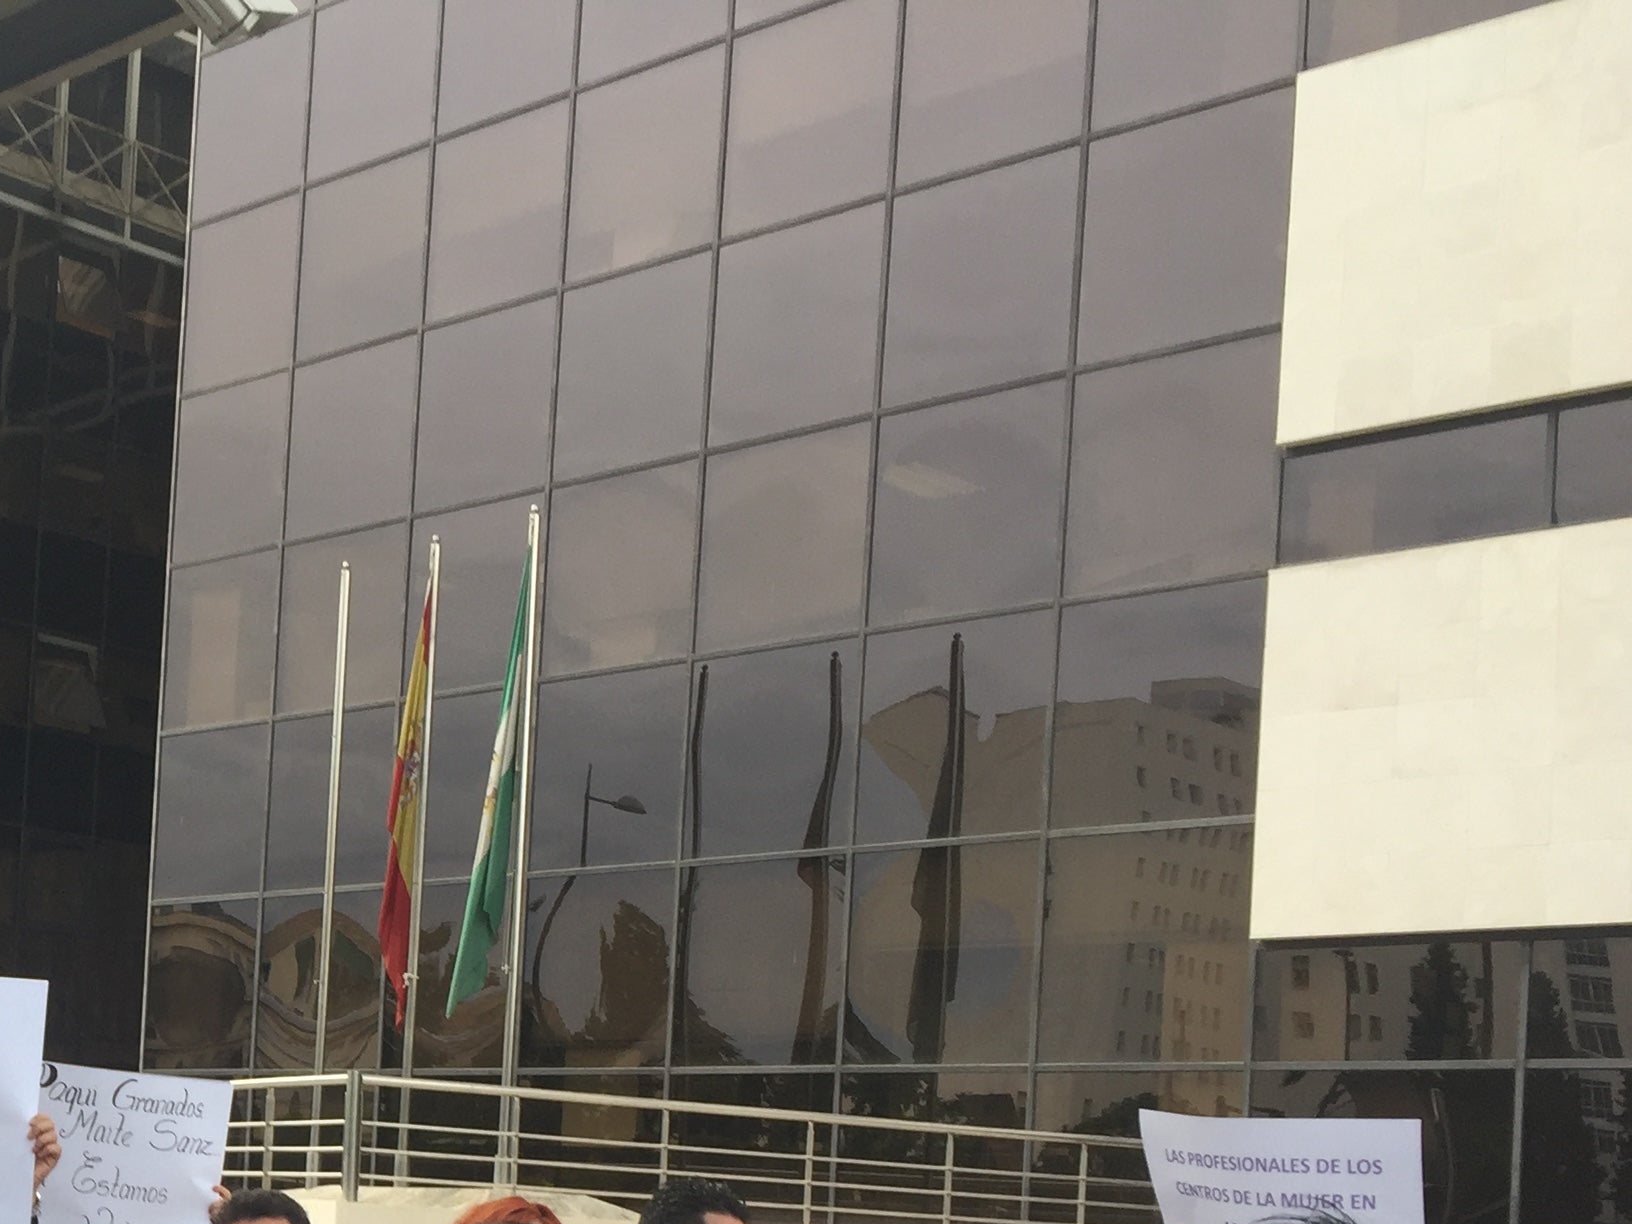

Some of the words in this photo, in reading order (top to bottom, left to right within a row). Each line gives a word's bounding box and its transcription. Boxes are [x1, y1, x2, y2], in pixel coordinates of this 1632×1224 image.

[59, 1109, 133, 1148] Maite
[71, 1151, 168, 1203] Estamos
[1165, 1149, 1185, 1164] LAS
[1188, 1151, 1310, 1174] PROFESIONALES
[1317, 1158, 1341, 1174] DE
[1346, 1159, 1383, 1175] LOS
[1176, 1181, 1230, 1203] CENTROS
[1233, 1190, 1252, 1206] DE
[1256, 1192, 1275, 1207] LA
[1281, 1192, 1345, 1211] MUJER
[1350, 1194, 1376, 1210] EN
